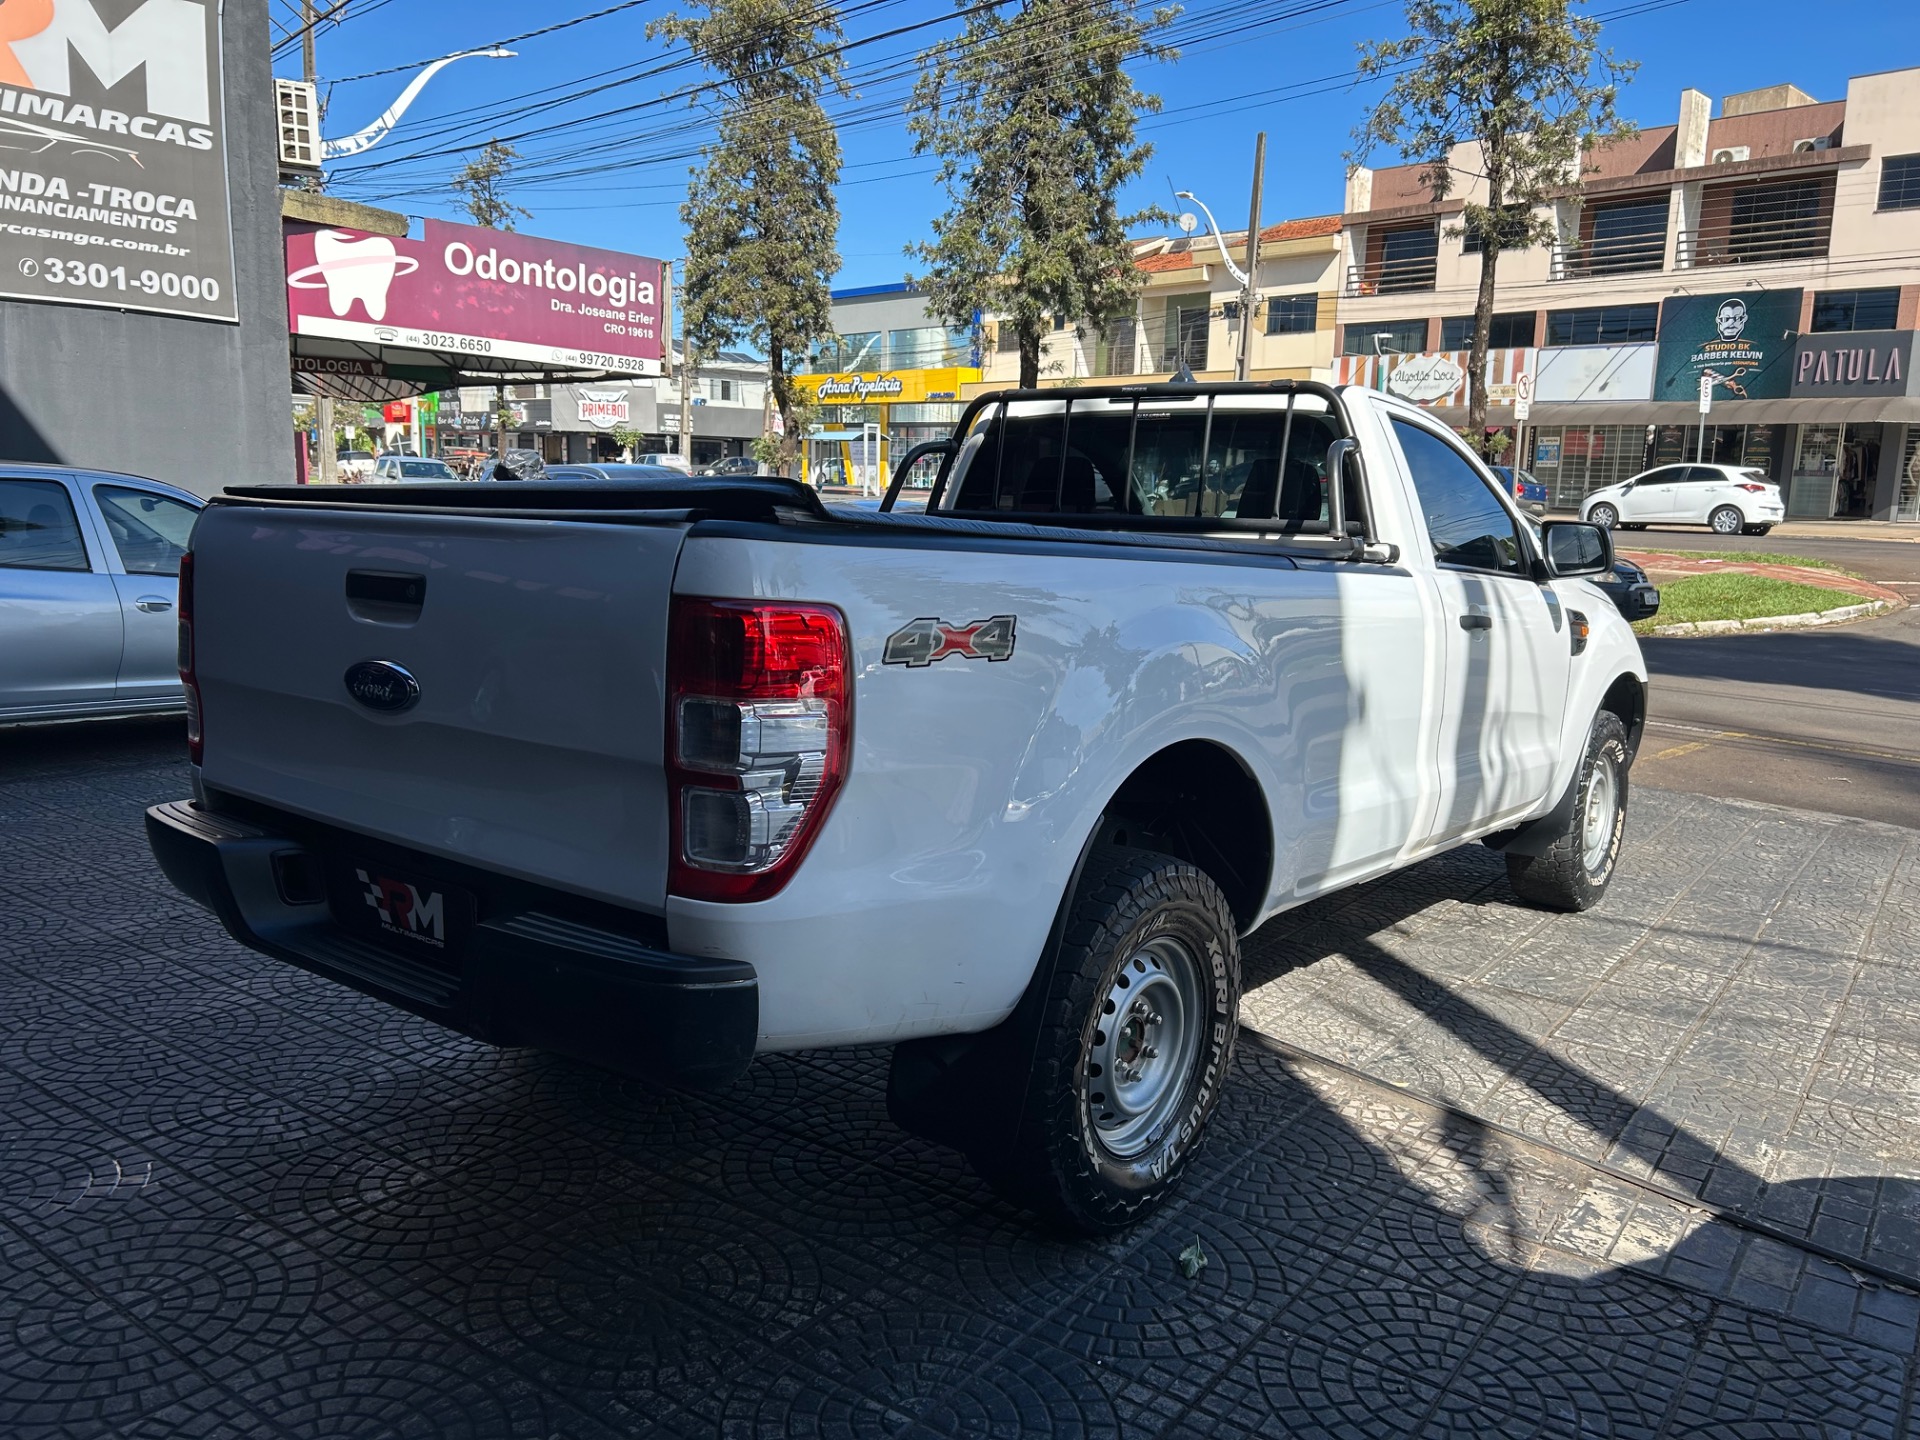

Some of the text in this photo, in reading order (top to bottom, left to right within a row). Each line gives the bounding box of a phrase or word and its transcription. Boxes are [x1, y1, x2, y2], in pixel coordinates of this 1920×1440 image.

[0, 89, 213, 150] IMARCAS
[43, 257, 220, 301] 3301-9000
[444, 241, 655, 308] Odontologia
[551, 298, 655, 325] Dra. Joseane Erler
[406, 333, 491, 352] (44) 3023.6650
[603, 323, 654, 339] CRO 19618
[1691, 350, 1763, 362] BARBER KELVIN
[1705, 343, 1736, 352] STUDIO
[565, 352, 644, 371] (44) 99720.5928
[1433, 369, 1456, 381] Doce
[1799, 347, 1900, 383] PATULA
[817, 374, 902, 400] Anna Papelaria
[582, 403, 626, 419] PRIMEBOI
[353, 672, 393, 701] Ford
[377, 878, 445, 941] RM
[1205, 935, 1228, 1015] XBRI
[1180, 1021, 1226, 1144] Brutus
